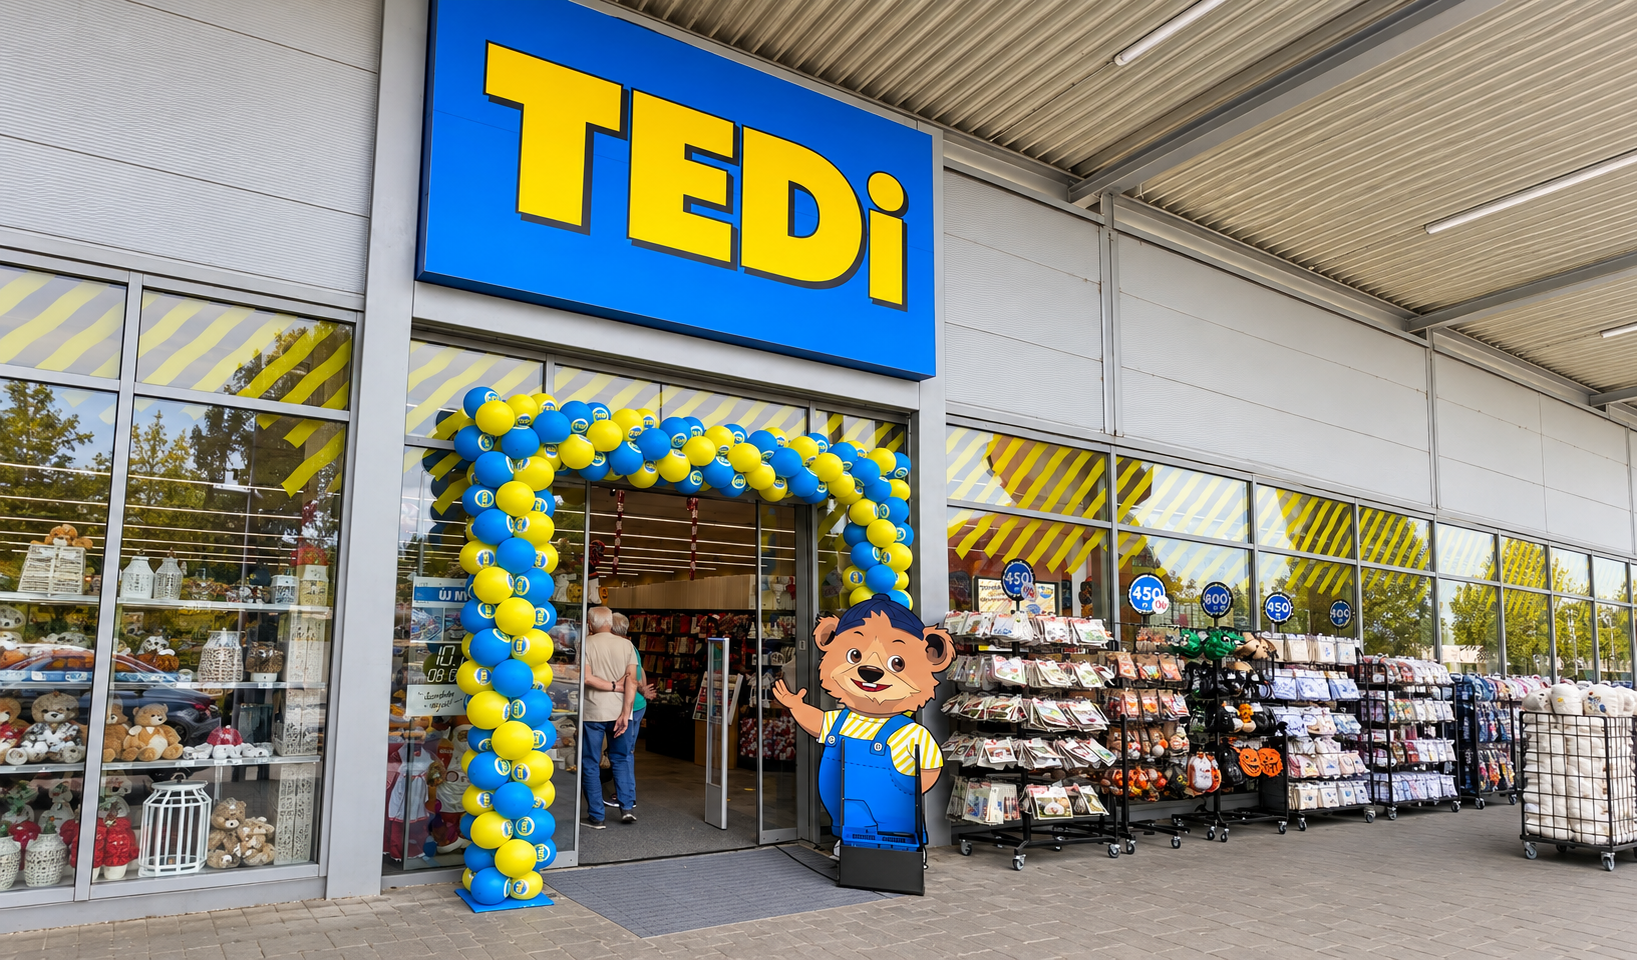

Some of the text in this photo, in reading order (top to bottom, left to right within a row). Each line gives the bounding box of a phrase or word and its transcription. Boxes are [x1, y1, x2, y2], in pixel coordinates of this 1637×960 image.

[484, 40, 908, 312] TEDi
[1005, 572, 1029, 584] 450
[1132, 586, 1161, 600] 450
[1267, 602, 1289, 613] 450
